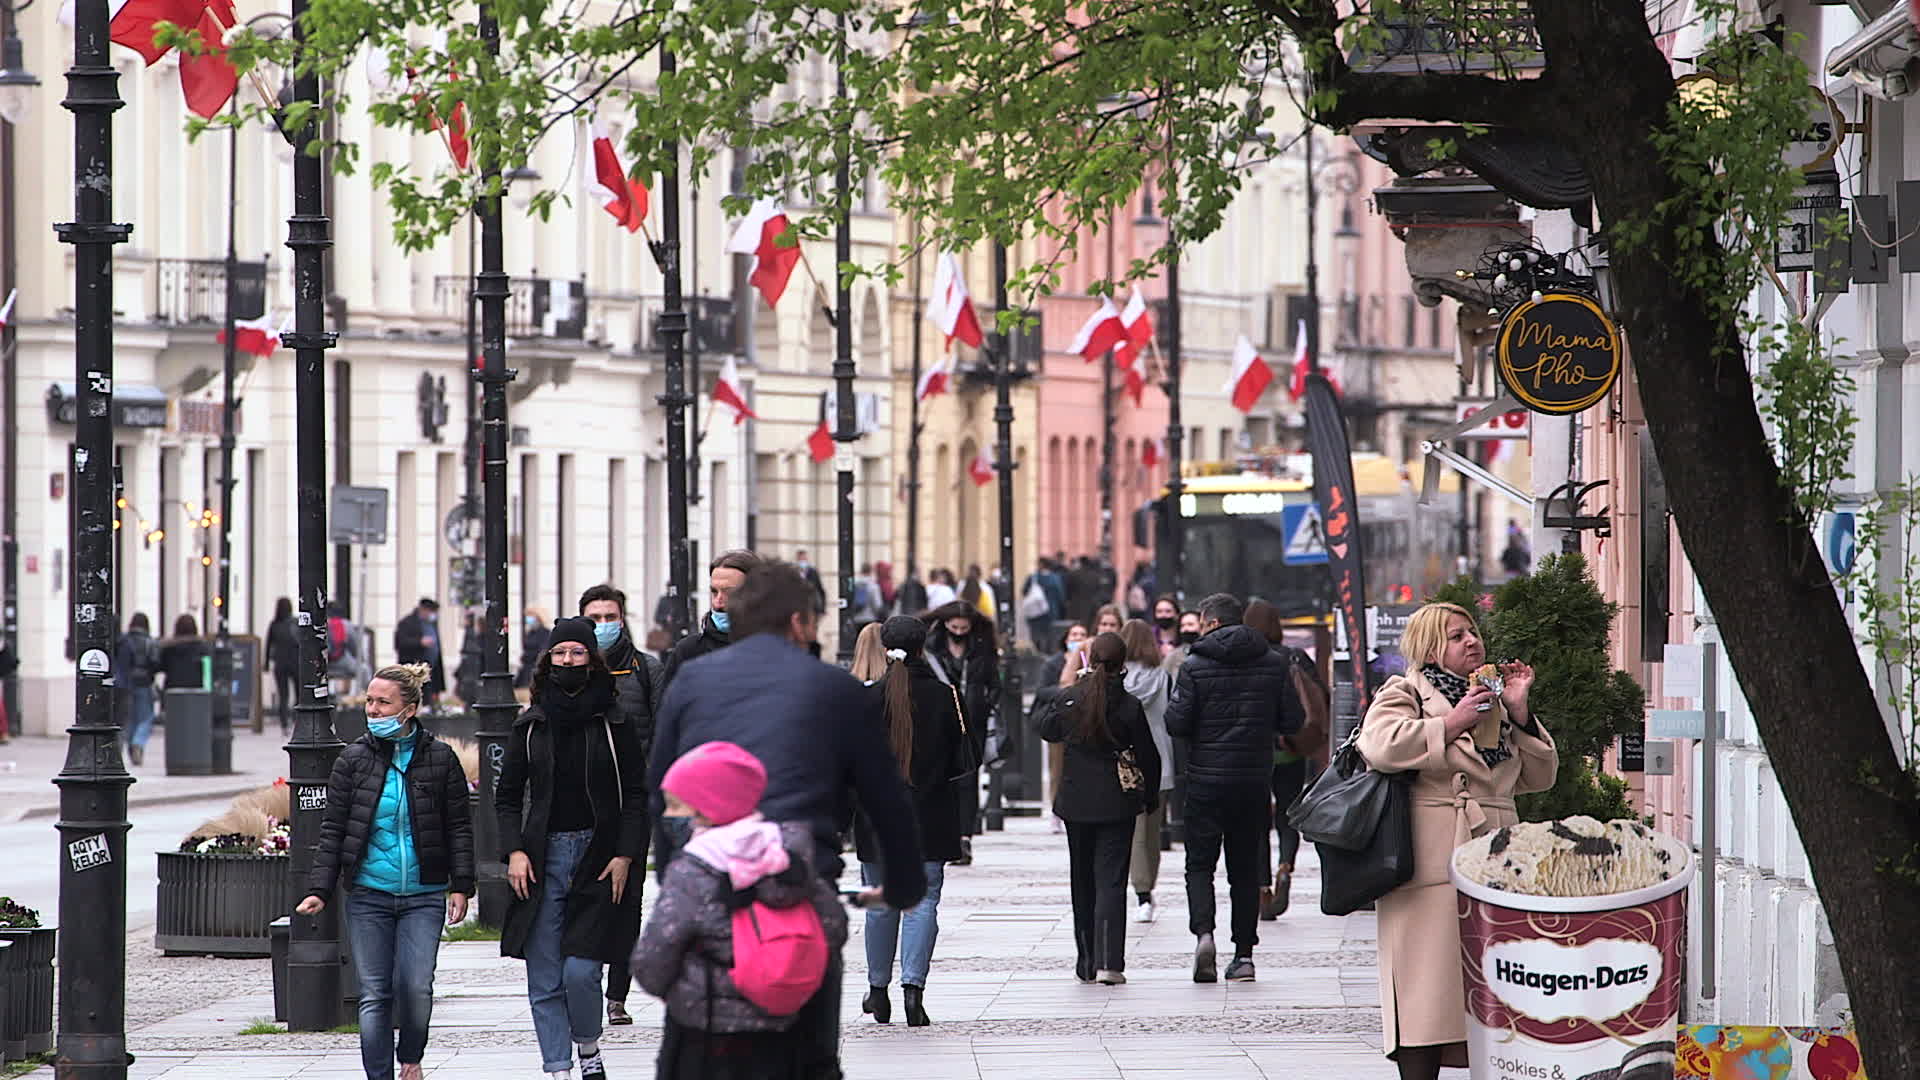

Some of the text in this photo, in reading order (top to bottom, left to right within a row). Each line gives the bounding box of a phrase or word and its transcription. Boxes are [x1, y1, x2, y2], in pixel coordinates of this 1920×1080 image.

[1513, 316, 1613, 351] Mama
[1526, 352, 1592, 389] Pho
[300, 786, 325, 798] AQTY
[73, 835, 100, 856] AQTY
[72, 850, 108, 870] XELOR
[1496, 958, 1648, 996] Häagen-Dazs
[1490, 1056, 1566, 1080] cookies &
